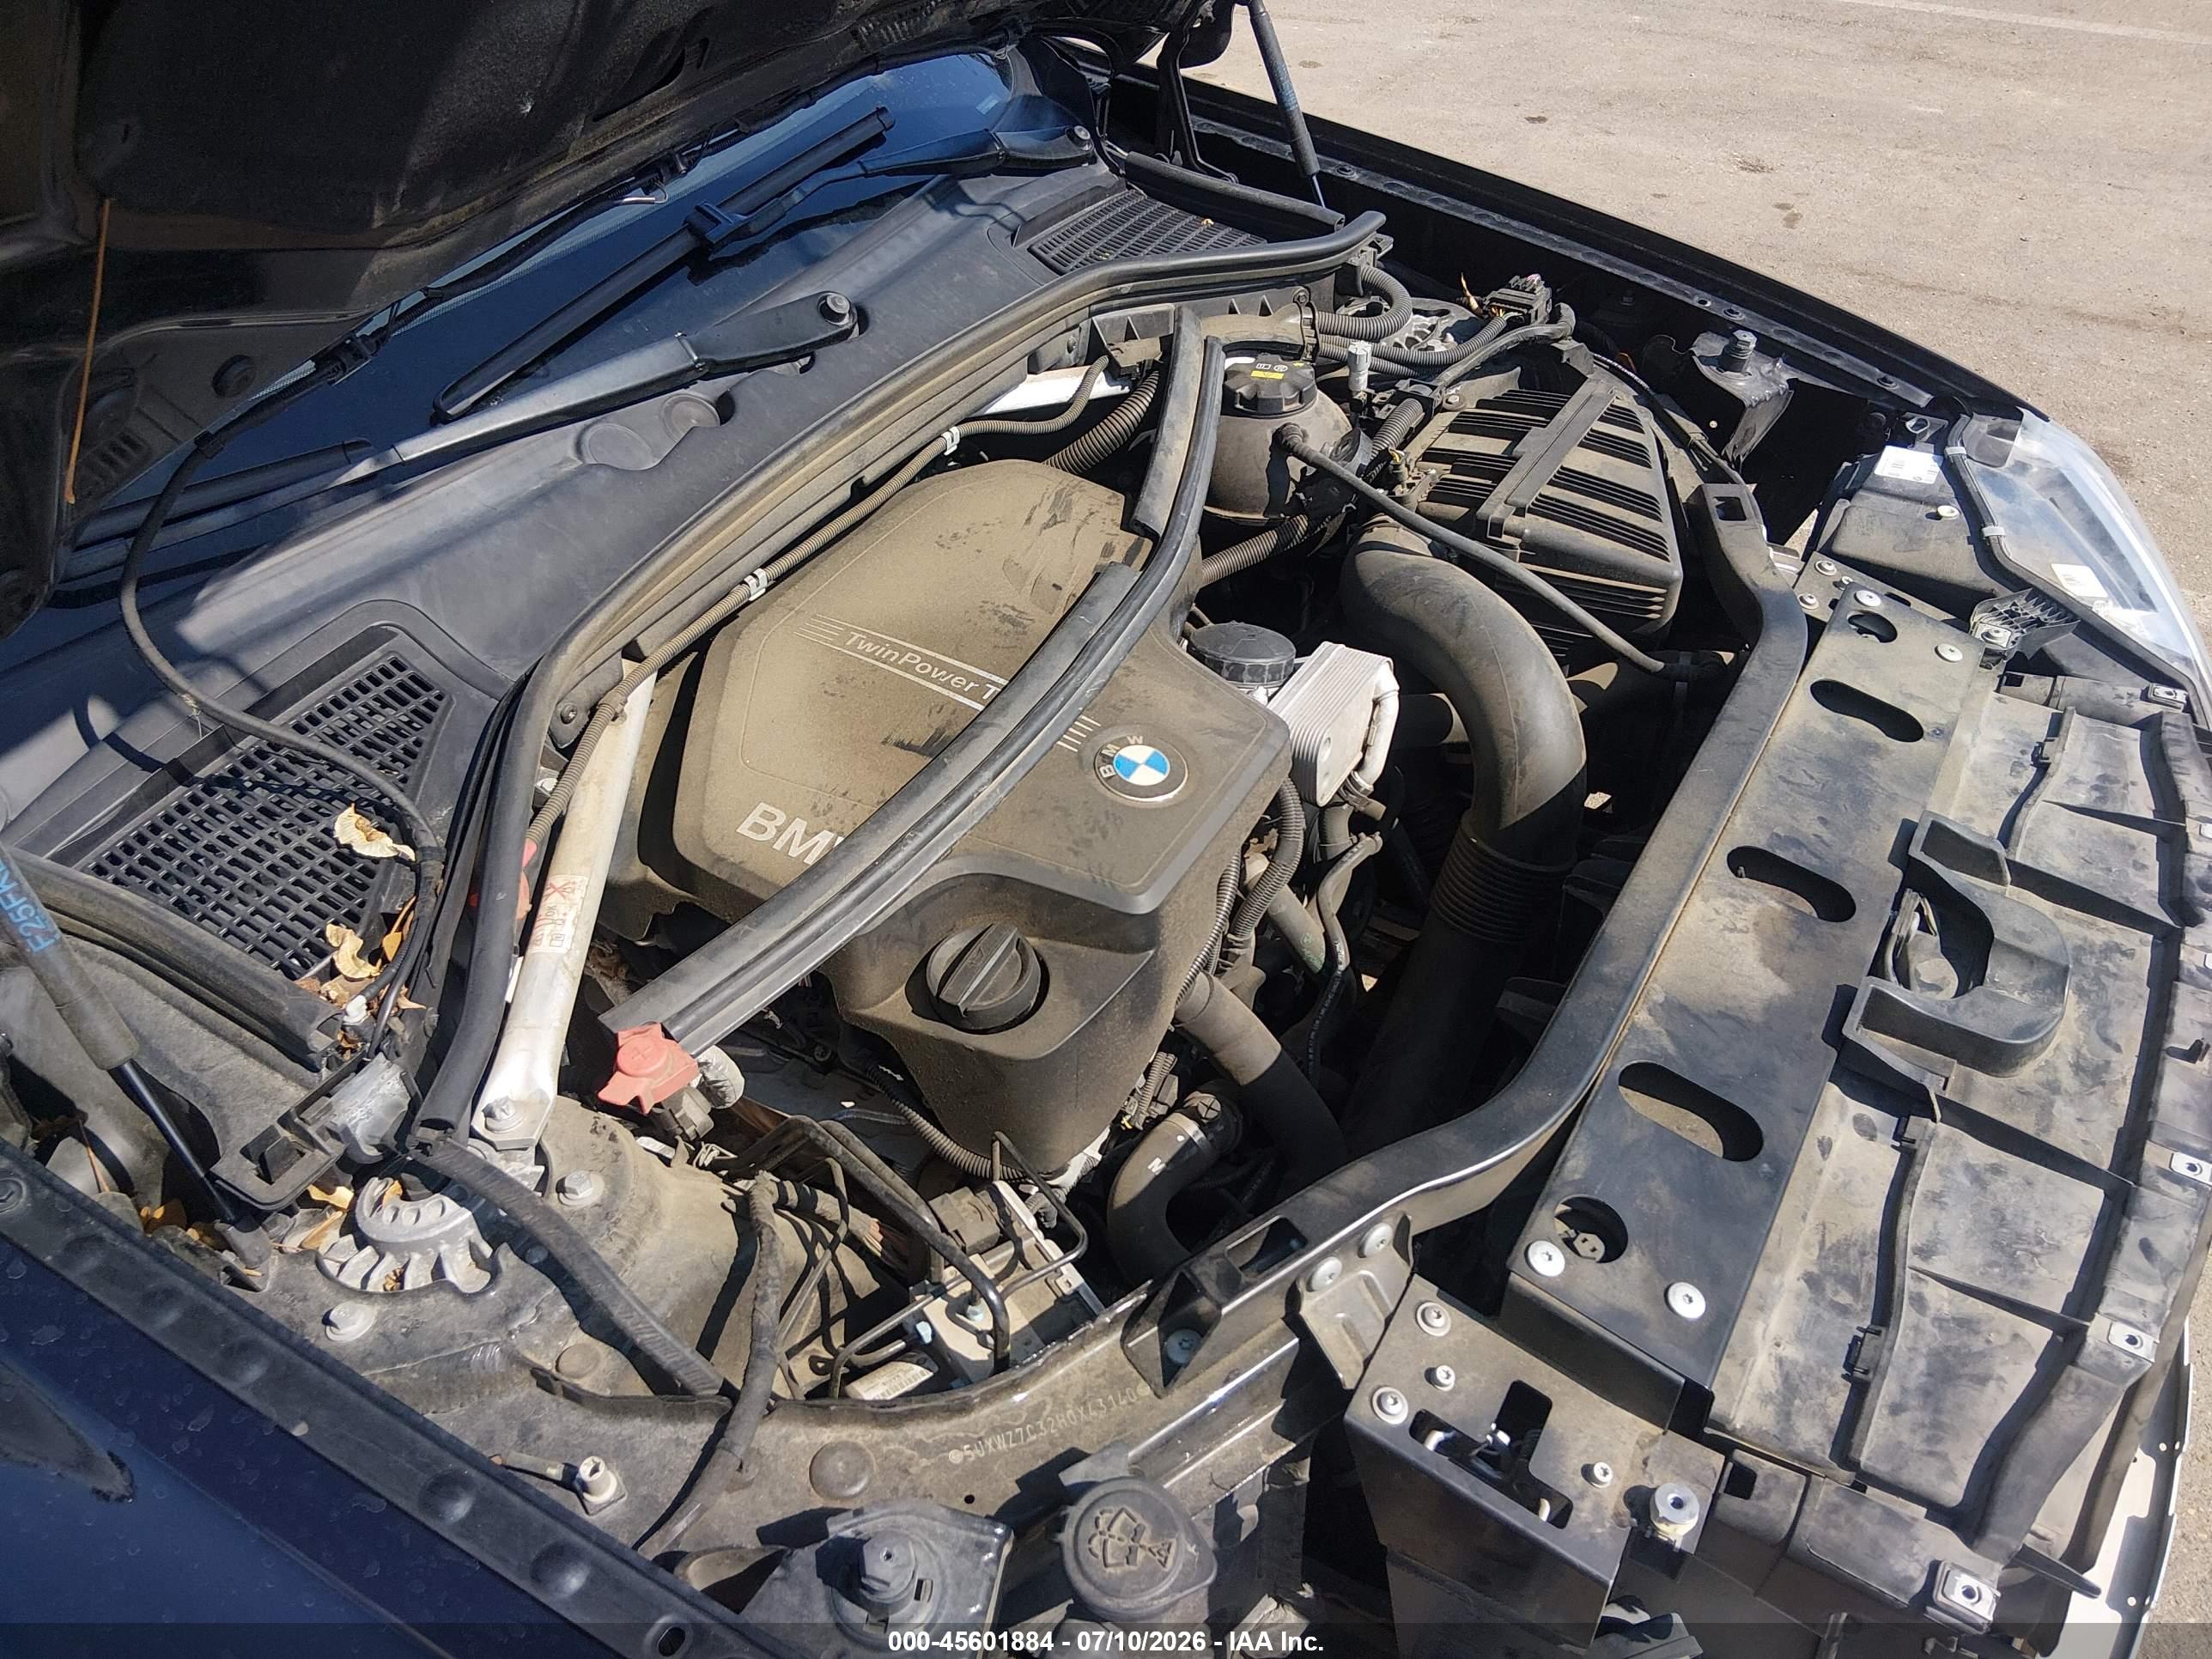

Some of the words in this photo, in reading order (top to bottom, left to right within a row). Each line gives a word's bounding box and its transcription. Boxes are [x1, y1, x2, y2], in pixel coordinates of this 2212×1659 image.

[843, 631, 980, 693] TwinPower
[1099, 735, 1145, 779] BMW
[736, 802, 844, 866] BM
